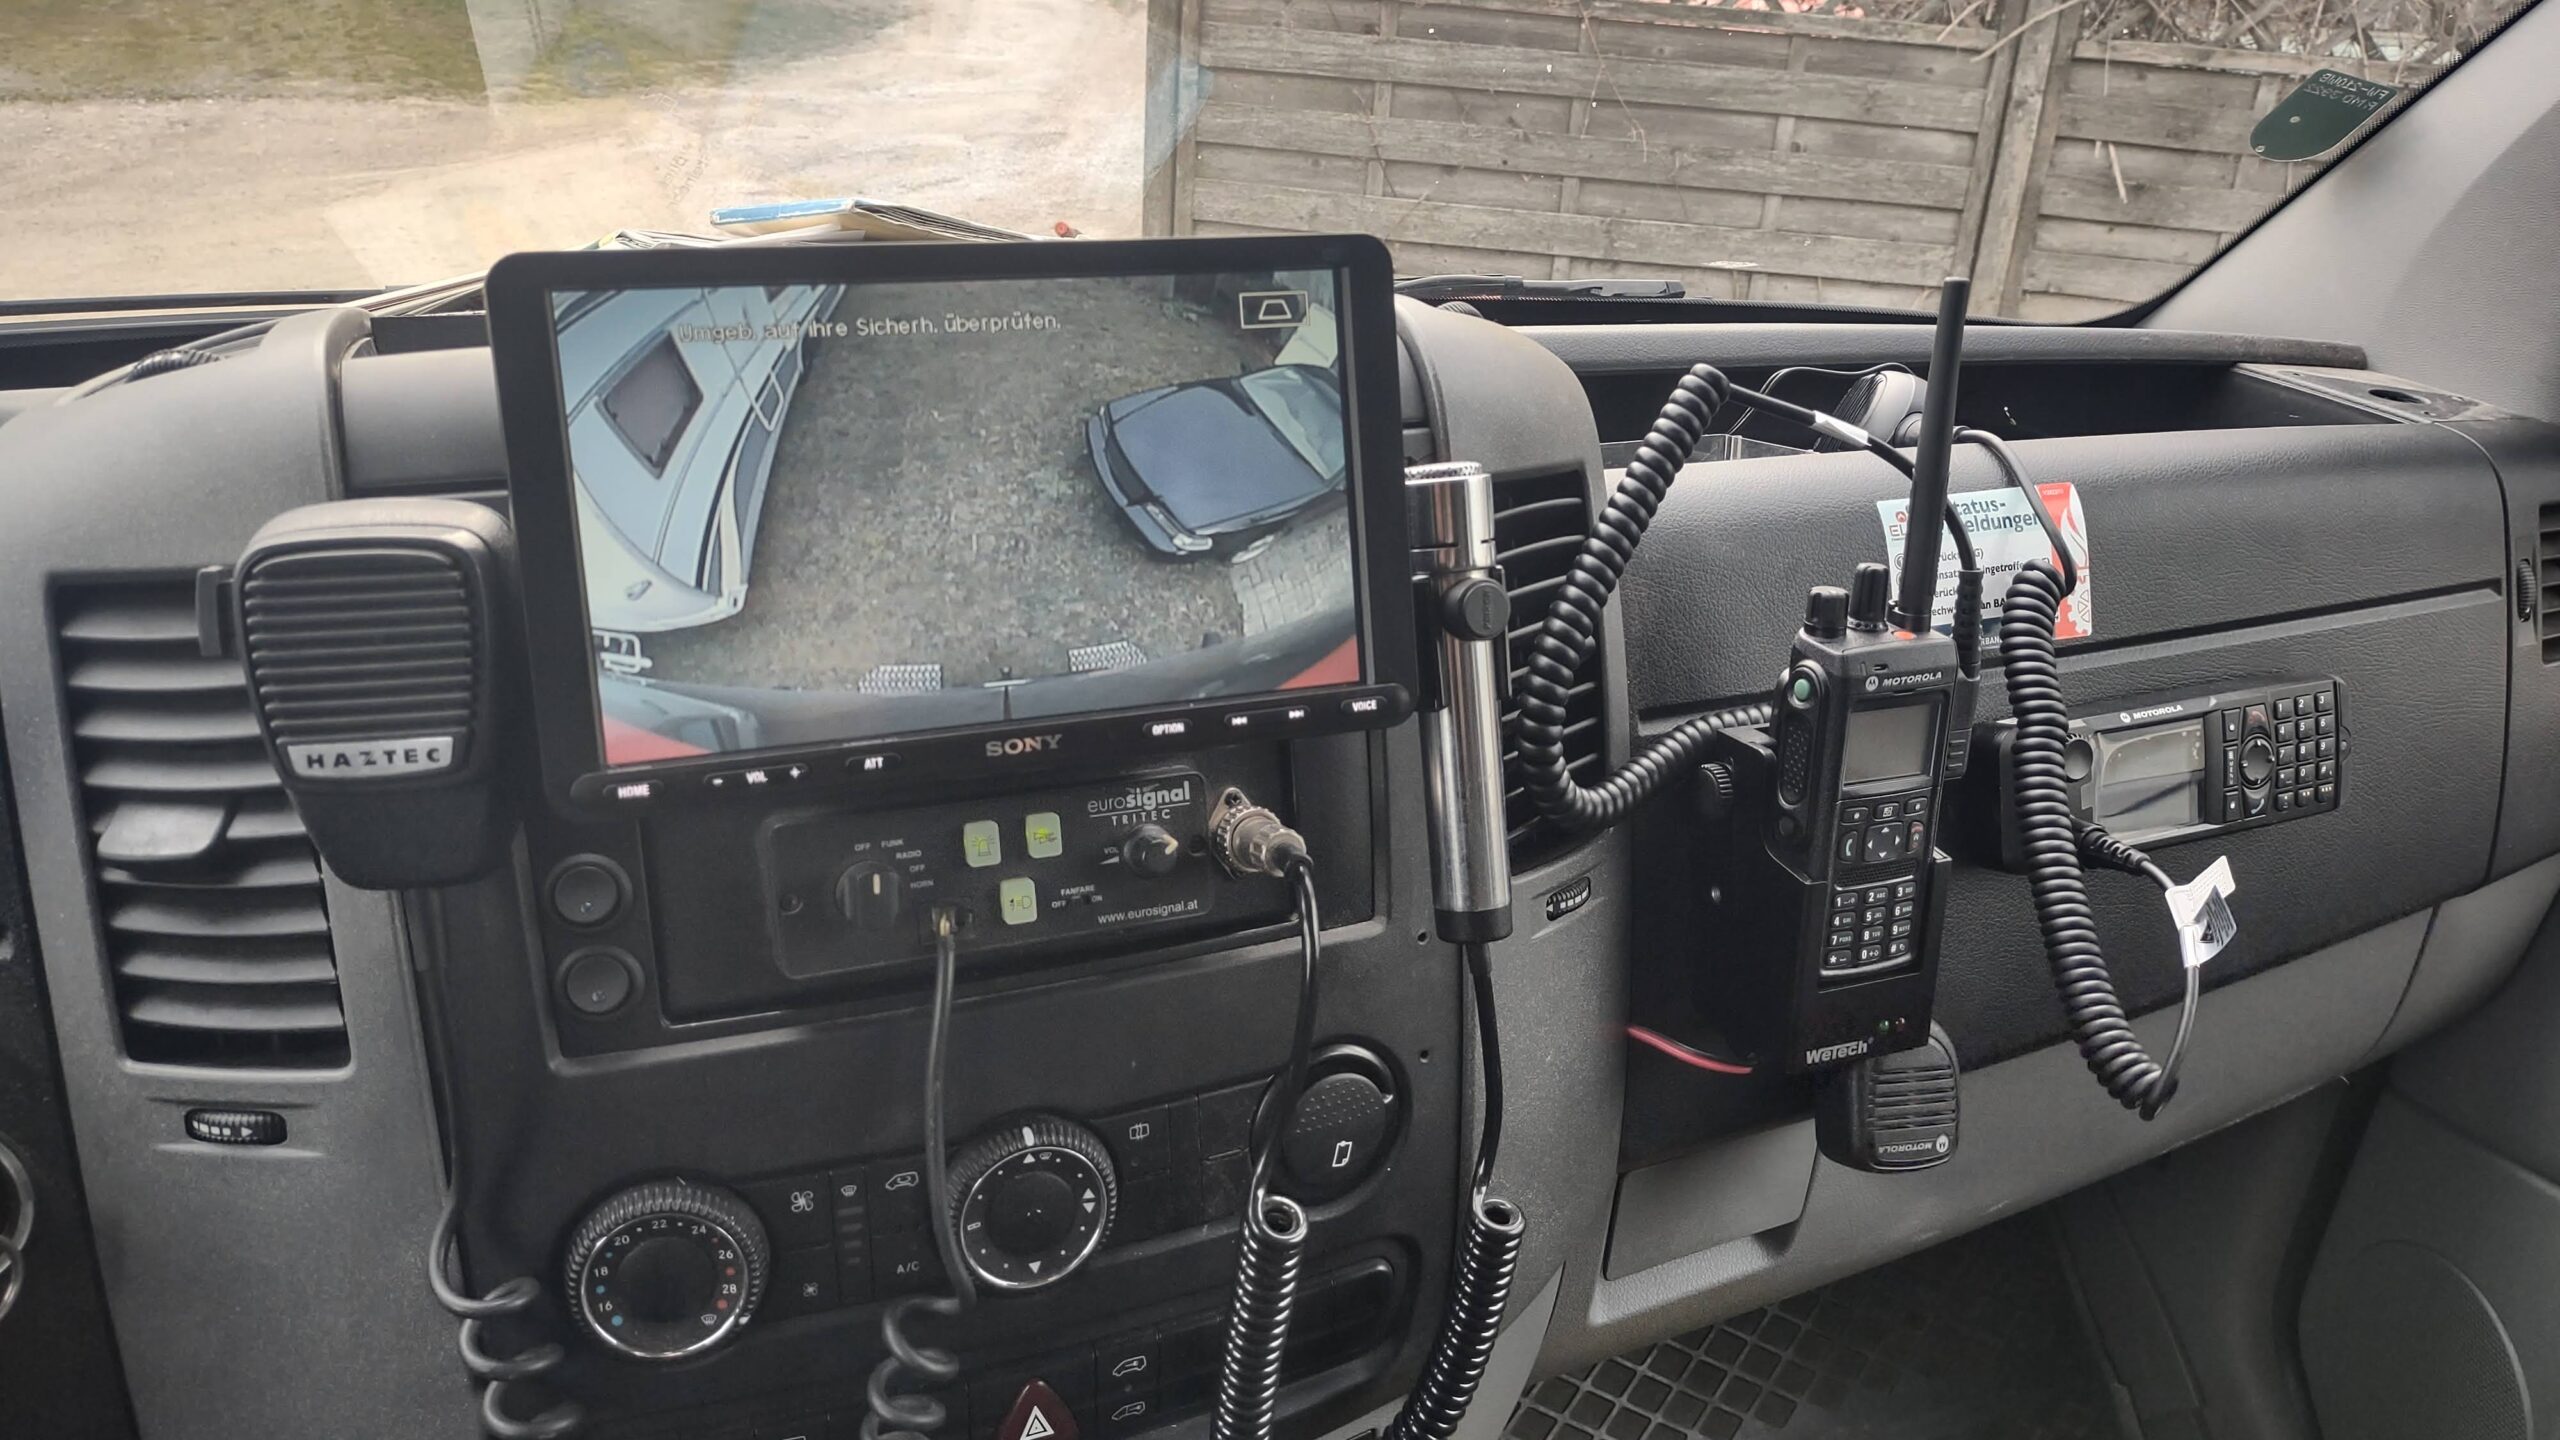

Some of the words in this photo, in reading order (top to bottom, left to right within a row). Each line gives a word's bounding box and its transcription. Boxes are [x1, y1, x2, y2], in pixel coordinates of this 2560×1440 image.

[679, 324, 758, 343] Umgeb.
[764, 323, 800, 340] auf
[857, 316, 938, 335] Sicherh.
[945, 312, 1062, 333] überprüfen.
[1955, 499, 2006, 514] tatus-
[1966, 513, 2039, 533] eldunge
[1883, 671, 1942, 687] MOTOROLA
[1352, 700, 1377, 713] VOICE
[2133, 705, 2183, 719] MOTOROLA
[1152, 723, 1185, 736] OPTION
[986, 735, 1062, 757] SONY
[306, 748, 441, 769] HAZTEC
[864, 757, 884, 770] ATT
[746, 771, 768, 784] VOL
[618, 784, 650, 799] HOME
[1087, 780, 1190, 813] eurosignal
[1111, 810, 1171, 826] TRITEC
[854, 842, 871, 851] OFF
[896, 850, 922, 860] RADIO
[1060, 884, 1095, 896] FANFARE
[1897, 887, 1904, 897] 3
[1836, 897, 1842, 907] 1
[1868, 892, 1875, 902] 2
[1052, 900, 1067, 909] OFF
[1098, 899, 1198, 924] www.eurosignal.at
[1866, 912, 1872, 921] 5
[1895, 906, 1901, 916] 6
[1834, 916, 1840, 926] 4
[1892, 925, 1898, 935] 9
[1832, 936, 1838, 946] 7
[1864, 931, 1870, 941] 8
[1861, 949, 1868, 959] 0
[1878, 1141, 1933, 1153] MOTOROLA
[651, 1219, 668, 1229] 22
[692, 1225, 707, 1235] 24
[614, 1235, 630, 1246] 20
[718, 1249, 734, 1260] 26
[594, 1266, 609, 1277] 18
[896, 1261, 920, 1275] A/C
[722, 1283, 737, 1294] 28
[598, 1301, 613, 1312] 16
